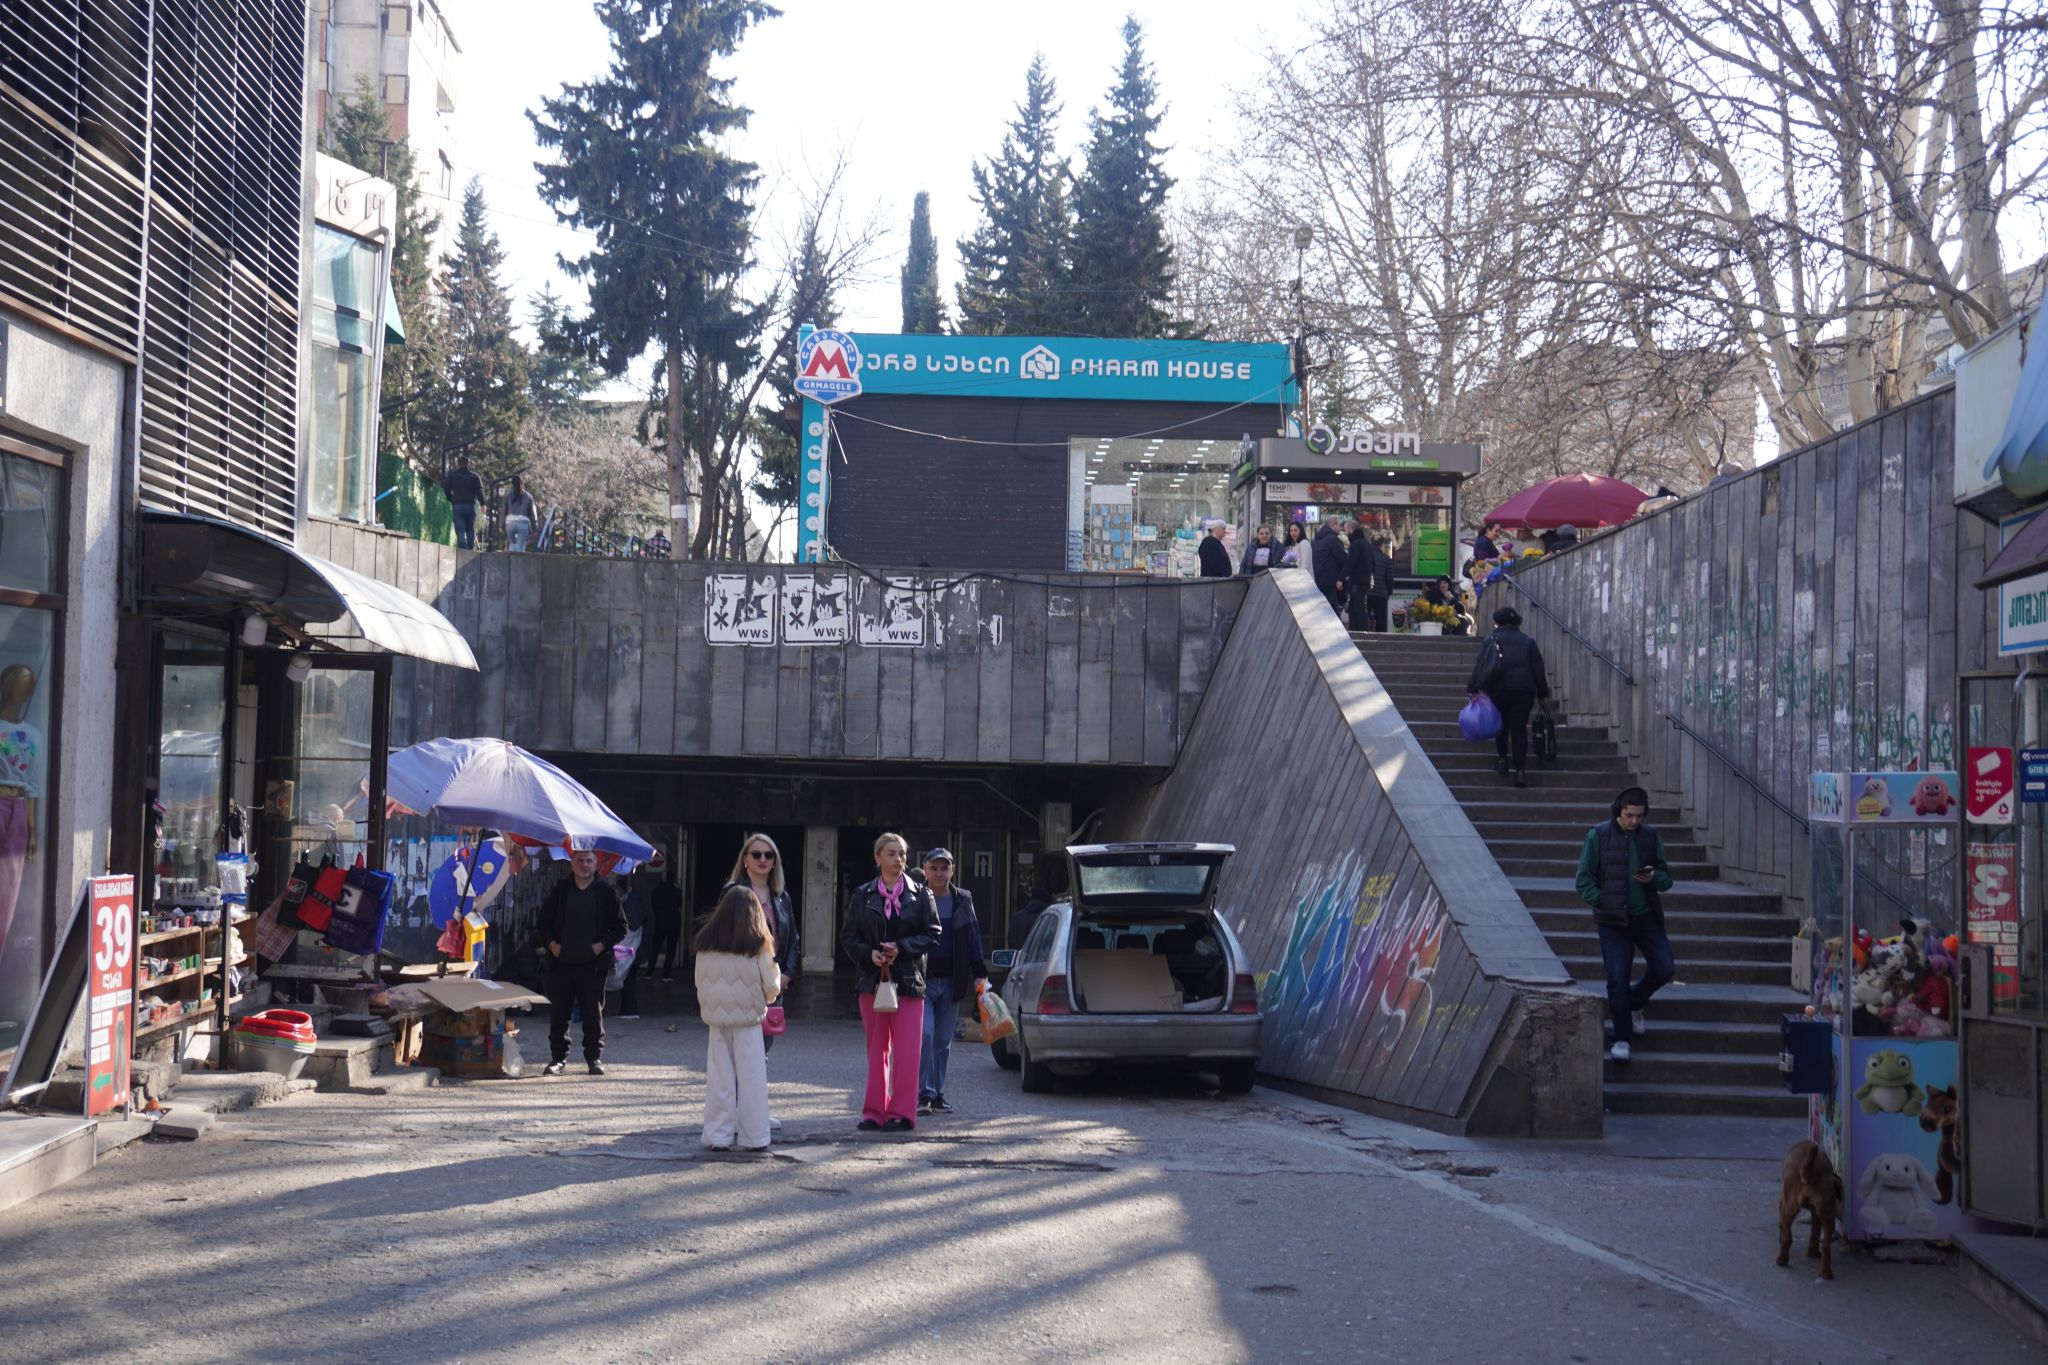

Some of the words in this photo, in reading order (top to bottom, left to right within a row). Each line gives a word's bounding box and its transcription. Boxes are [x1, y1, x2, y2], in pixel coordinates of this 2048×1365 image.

[1071, 358, 1159, 377] PHARM
[1168, 360, 1251, 380] HOUSE
[803, 381, 852, 391] GRMAGELE
[2009, 586, 2048, 629] კომპი
[95, 903, 132, 971] 39
